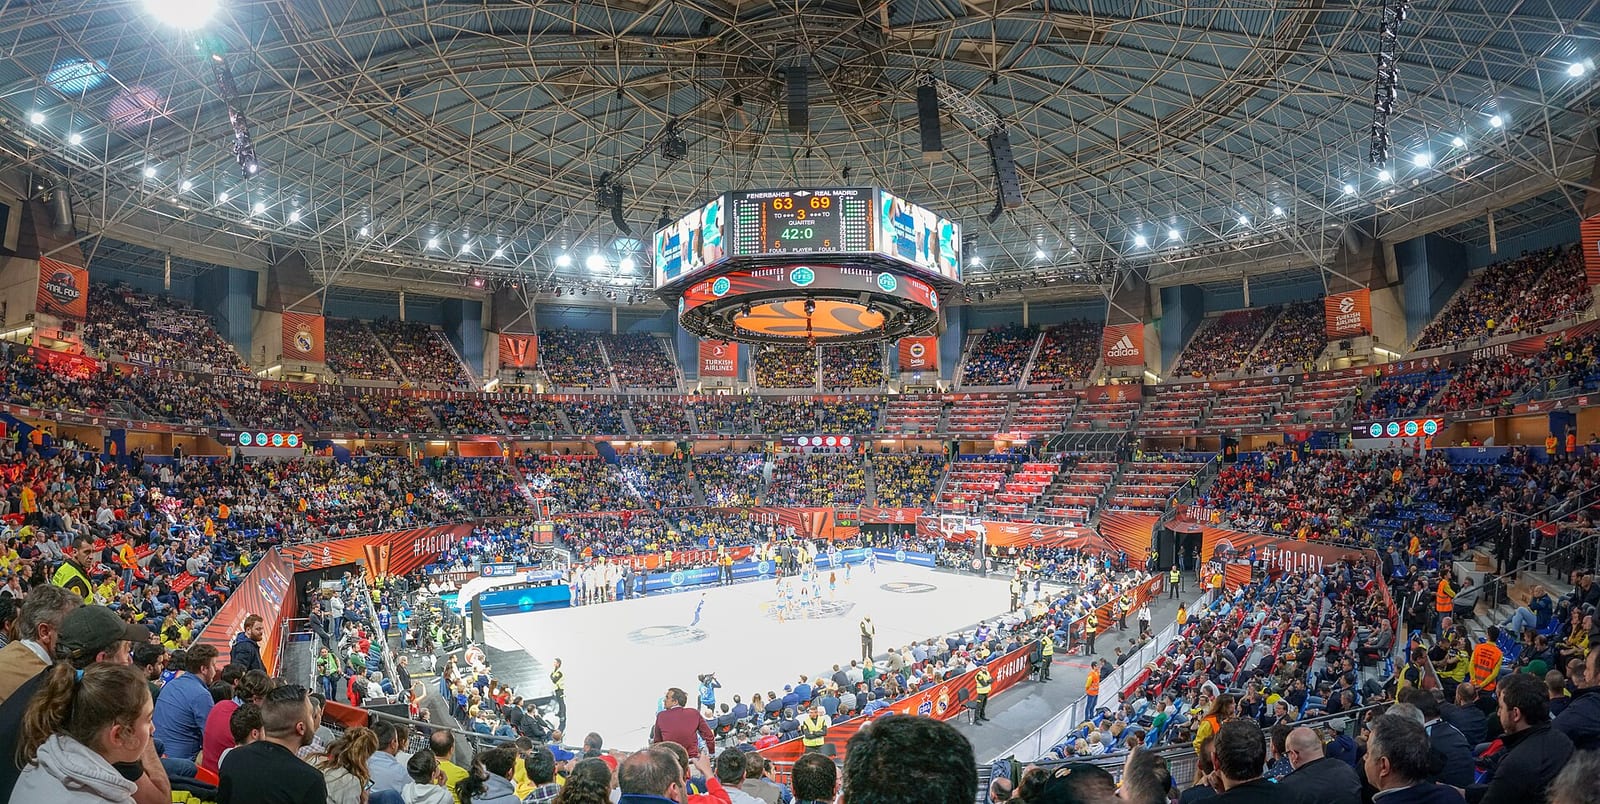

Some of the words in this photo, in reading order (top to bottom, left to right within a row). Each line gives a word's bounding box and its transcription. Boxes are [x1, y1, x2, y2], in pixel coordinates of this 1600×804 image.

[773, 197, 794, 210] 63
[810, 196, 831, 209] 69
[796, 209, 806, 220] 3
[823, 239, 831, 247] 5
[751, 267, 784, 277] PRESENTED
[840, 267, 873, 277] PRESENTED
[1107, 347, 1139, 357] adidas
[413, 533, 455, 557] #F4GLORY
[1262, 546, 1324, 574] #F4GLORY
[996, 654, 1028, 682] #F4GLORY
